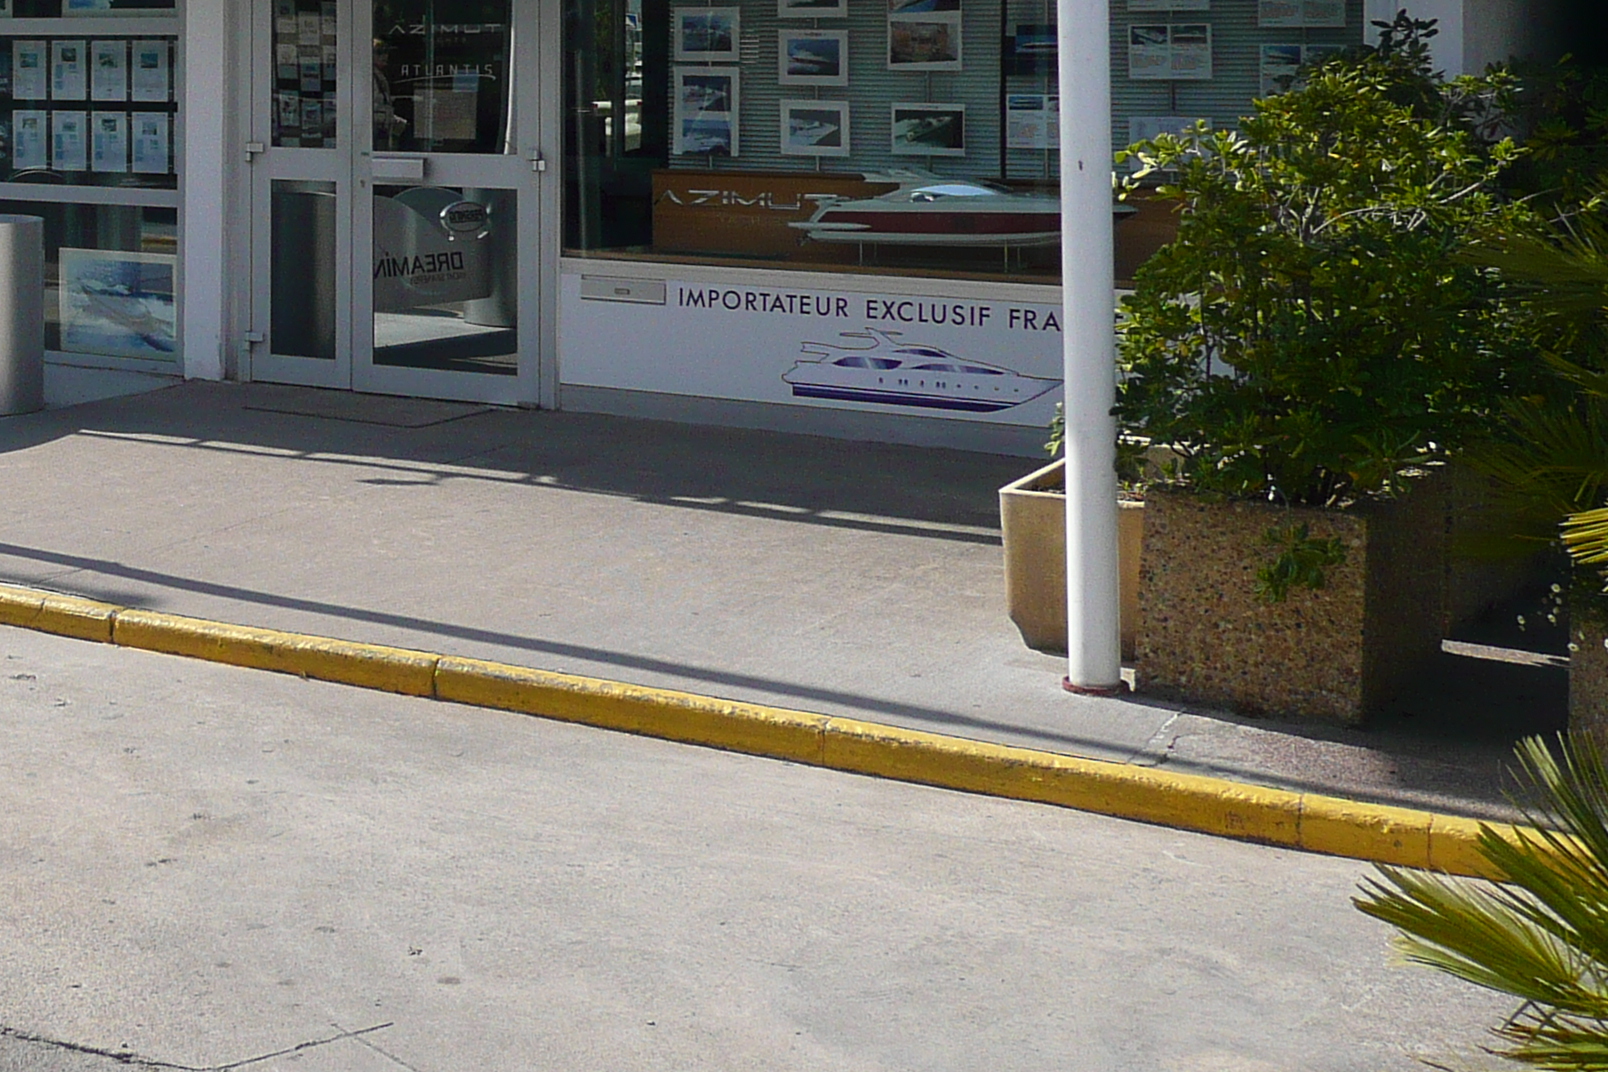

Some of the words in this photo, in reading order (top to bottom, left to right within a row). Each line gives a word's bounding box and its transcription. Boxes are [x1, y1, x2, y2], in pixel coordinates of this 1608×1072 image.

[400, 64, 493, 77] ATLANTIS
[678, 287, 850, 319] IMPORTATEUR
[865, 299, 992, 328] EXCLUSIF
